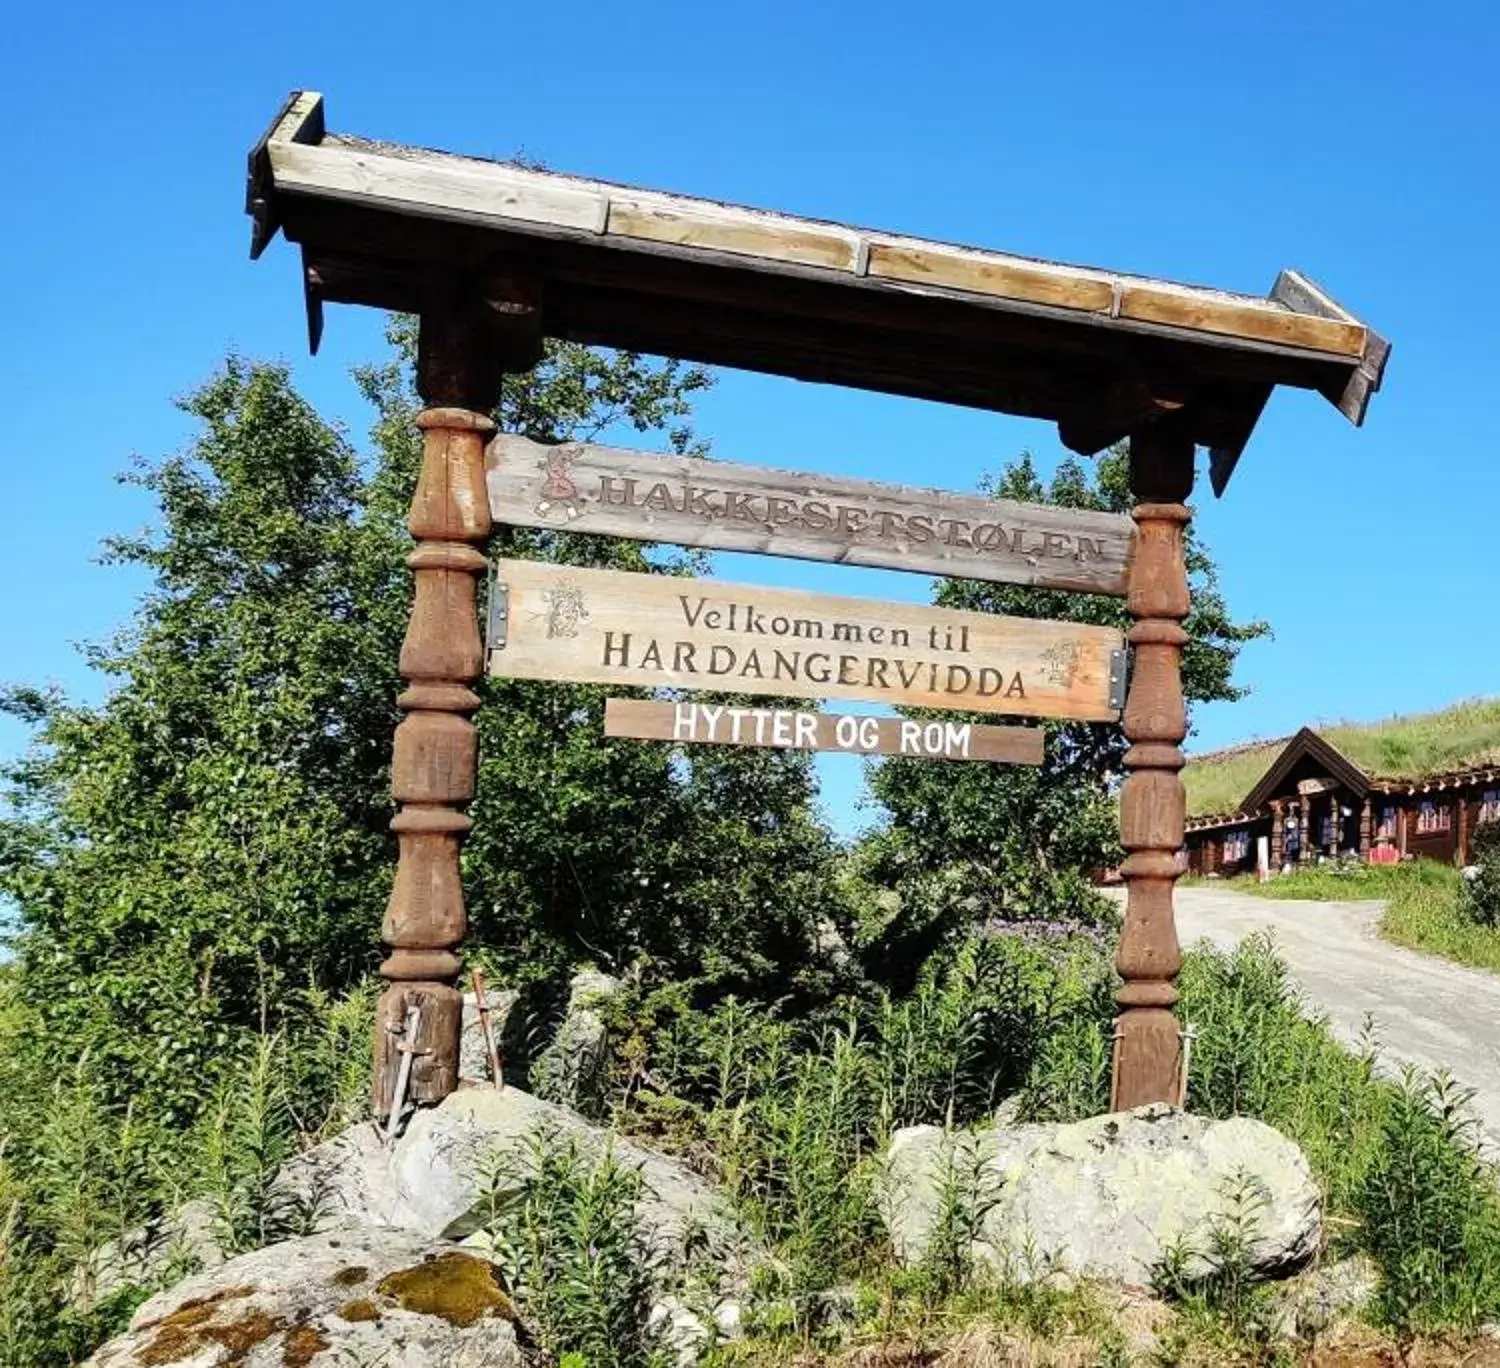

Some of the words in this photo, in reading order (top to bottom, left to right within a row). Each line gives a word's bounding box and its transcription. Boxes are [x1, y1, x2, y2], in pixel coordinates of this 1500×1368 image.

[595, 474, 1108, 564] HAKKESETSTØLEN
[679, 594, 910, 648] Velkommen
[928, 623, 970, 652] til
[602, 631, 1027, 699] HARDANGERVIDDA
[673, 703, 819, 748] HYTTER
[836, 715, 879, 749] OG
[900, 720, 972, 757] ROM
